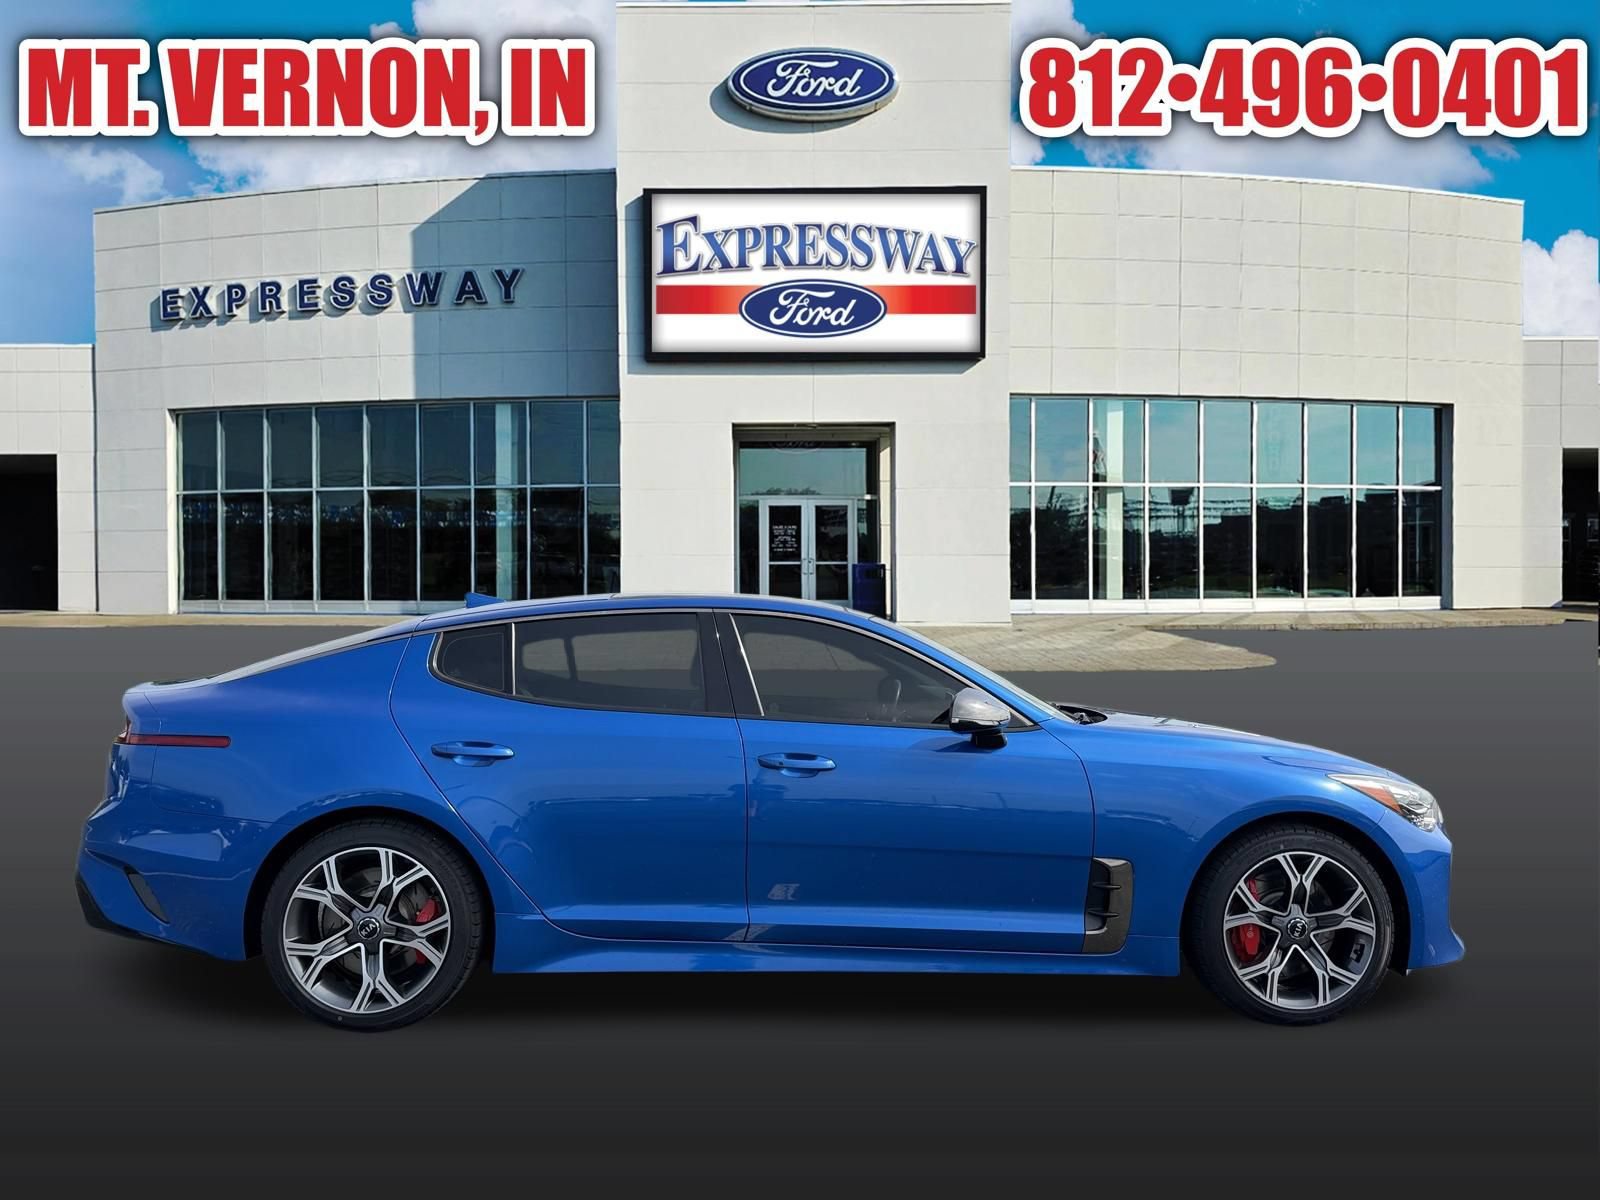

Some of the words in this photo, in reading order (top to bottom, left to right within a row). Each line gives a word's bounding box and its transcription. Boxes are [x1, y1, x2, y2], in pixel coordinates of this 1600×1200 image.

[766, 60, 864, 97] Ford
[159, 268, 525, 321] EXPRESSWAY
[769, 289, 857, 327] Ford
[360, 923, 376, 937] KIA
